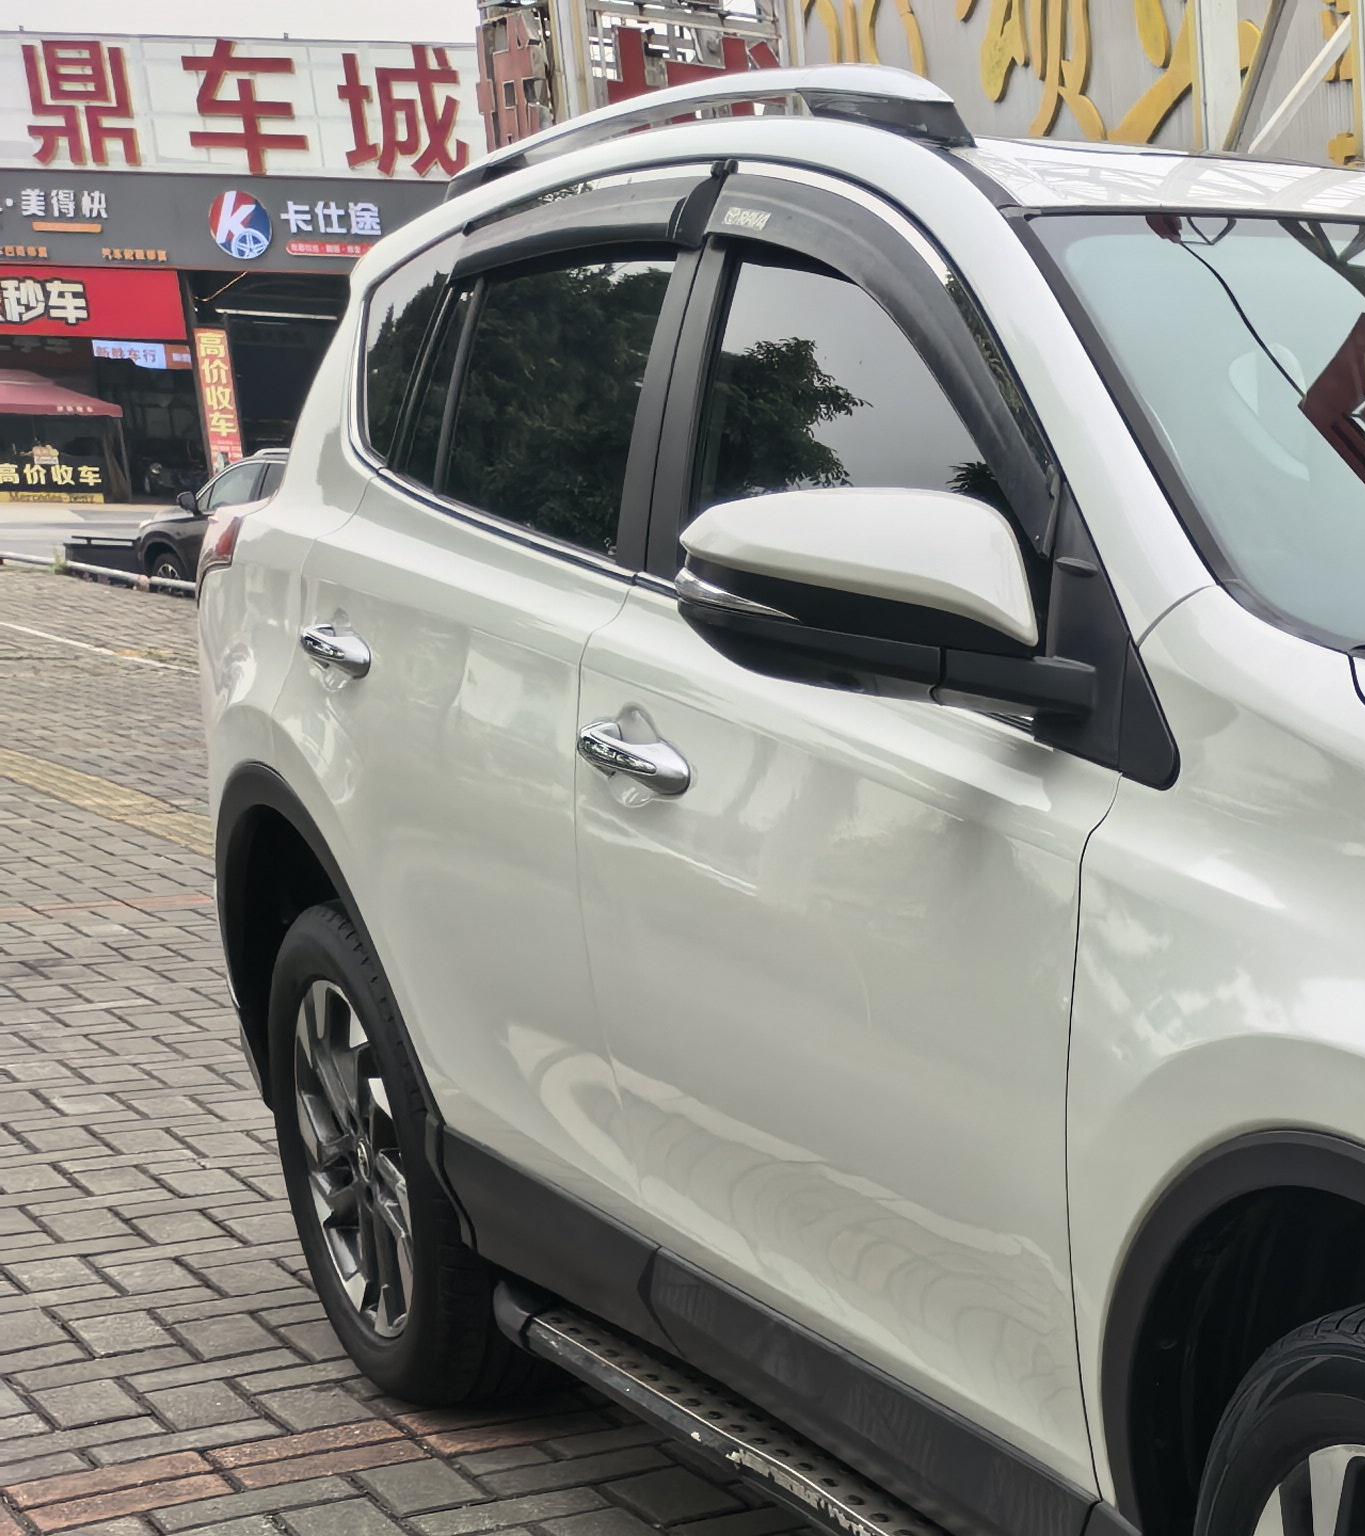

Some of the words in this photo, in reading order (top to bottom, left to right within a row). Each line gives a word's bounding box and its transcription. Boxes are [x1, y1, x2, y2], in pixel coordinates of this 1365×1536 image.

[21, 37, 470, 177] 鼎车城
[280, 200, 382, 236] 卡仕途
[0, 279, 89, 324] 秒车
[197, 332, 238, 438] 高价收车
[0, 463, 102, 486] 高价收车
